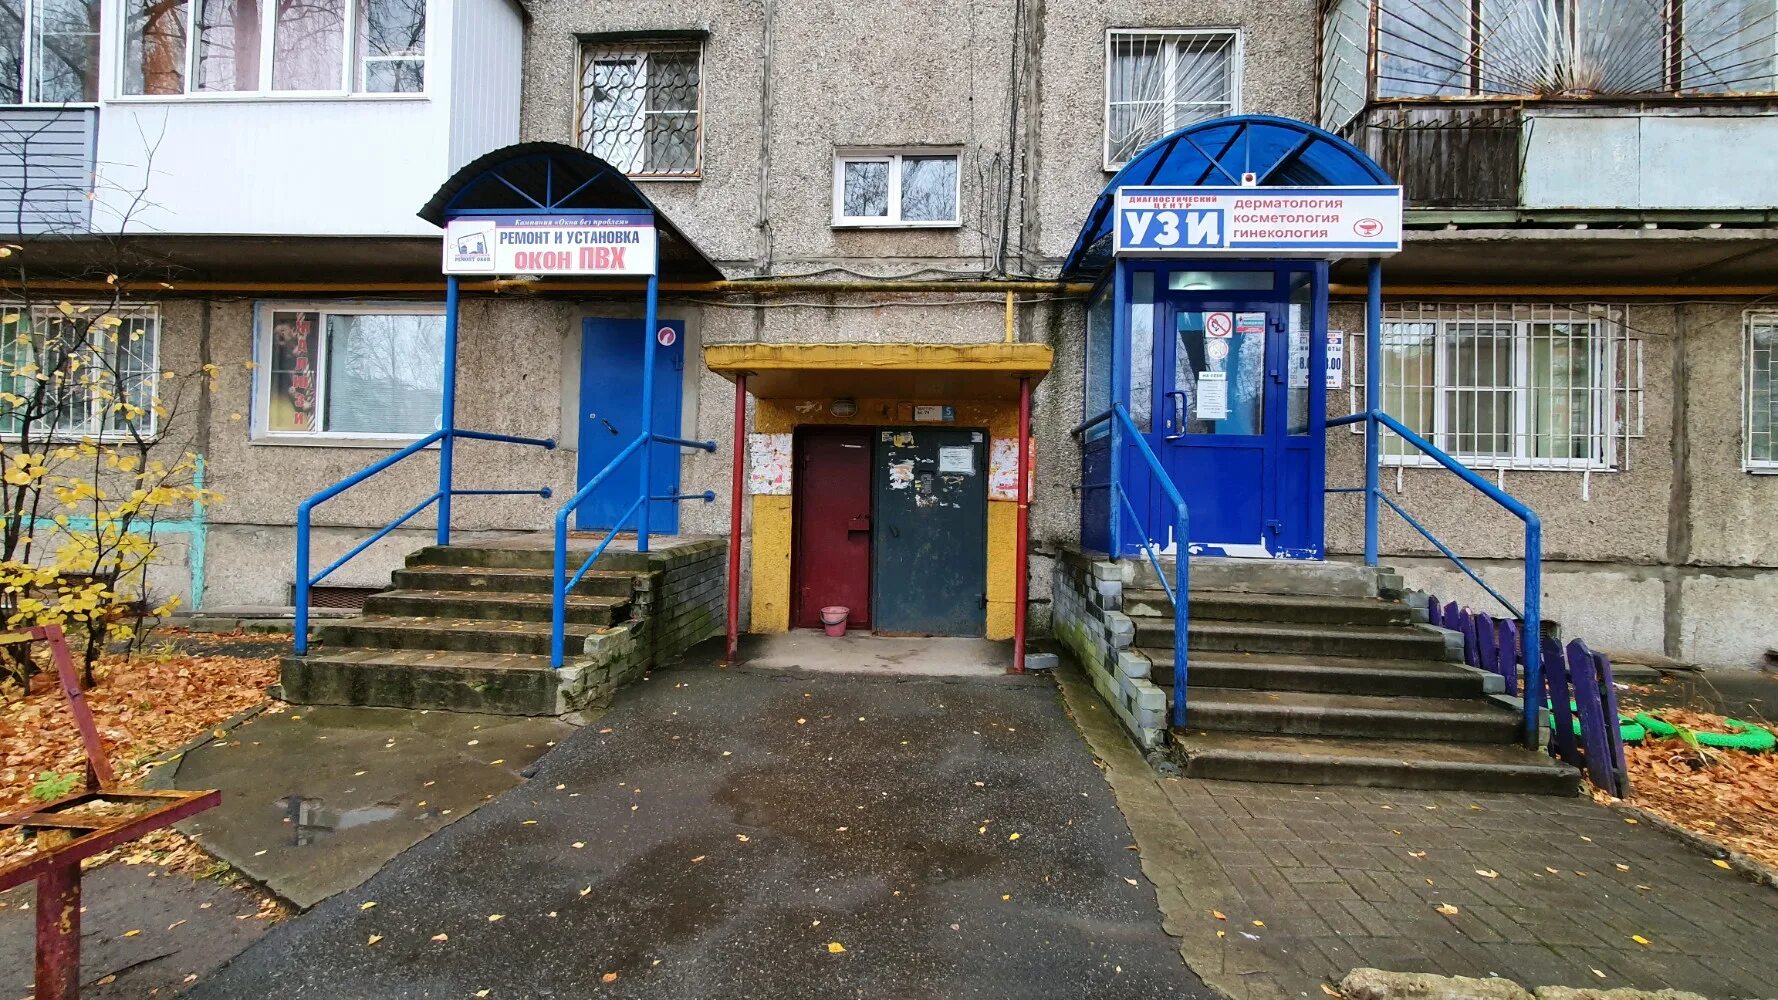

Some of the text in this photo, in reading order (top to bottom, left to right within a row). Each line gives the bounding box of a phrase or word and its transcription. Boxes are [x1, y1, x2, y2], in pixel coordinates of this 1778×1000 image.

[1234, 199, 1343, 210] дерматология
[1233, 214, 1340, 223] косметология
[1125, 211, 1220, 246] УЗИ
[1233, 229, 1328, 238] гинекология
[500, 231, 550, 245] РЕМОНТ
[554, 231, 563, 244] И
[567, 230, 640, 244] УСТАНОВКА
[514, 247, 626, 270] ОКОН ПВХ
